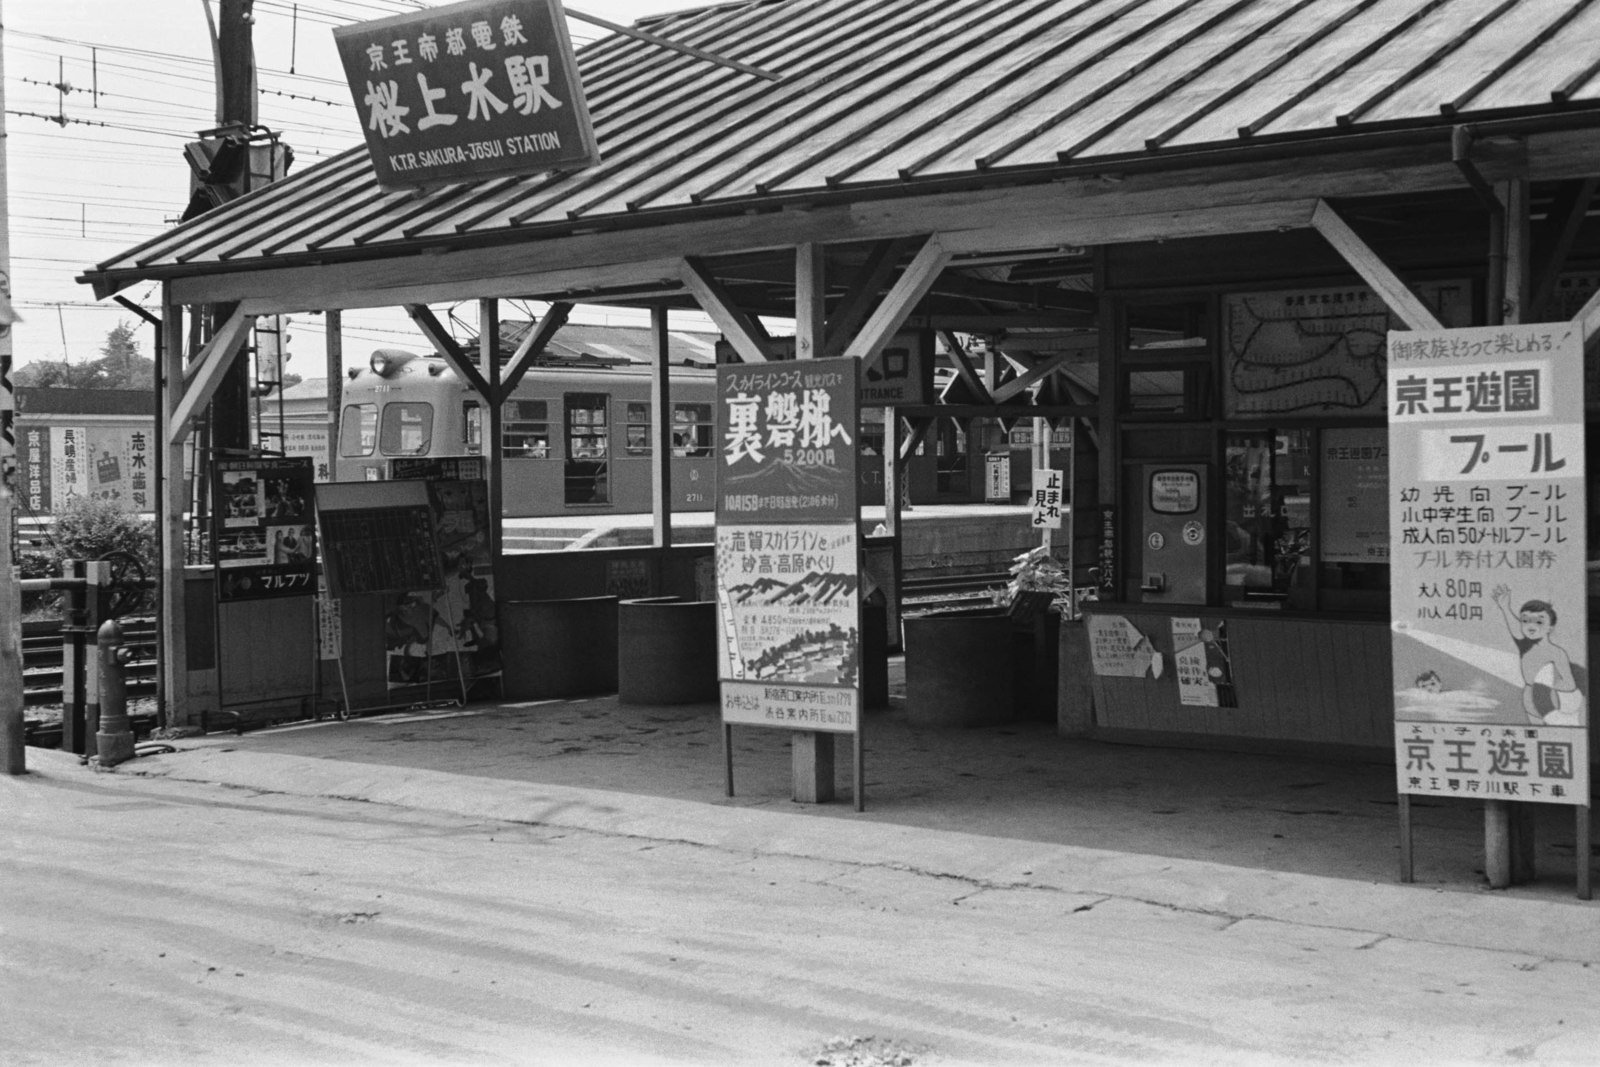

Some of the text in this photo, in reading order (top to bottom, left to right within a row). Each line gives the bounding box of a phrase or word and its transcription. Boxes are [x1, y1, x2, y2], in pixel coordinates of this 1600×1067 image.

[366, 14, 528, 71] 京王帝都電鉄
[364, 55, 562, 138] 桜上水駅
[506, 131, 561, 153] STATION
[1395, 368, 1540, 415] 京王遊園
[723, 388, 852, 466] 裏磐梯へ
[131, 431, 147, 508] 志水歯科
[1450, 432, 1566, 474] プール
[686, 493, 703, 502] 2711
[1034, 489, 1047, 525] 見よ
[1046, 473, 1060, 518] 止まれ
[1445, 602, 1483, 620] 40円
[1446, 578, 1482, 599] 80円
[1403, 735, 1574, 780] 京王遊園
